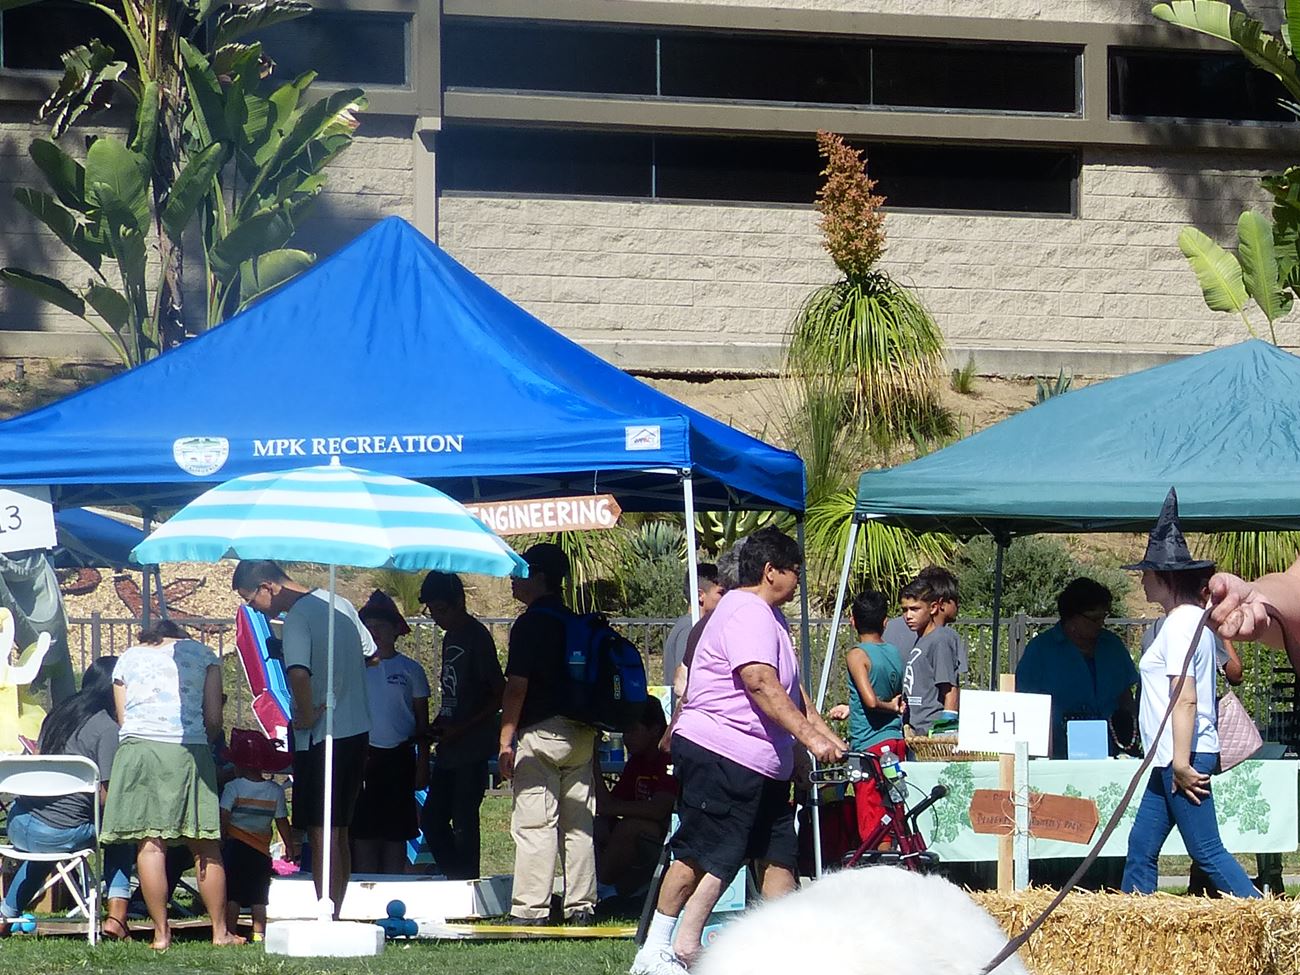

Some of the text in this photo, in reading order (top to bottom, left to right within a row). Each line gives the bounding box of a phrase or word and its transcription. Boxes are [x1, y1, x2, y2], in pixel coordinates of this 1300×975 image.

[252, 434, 464, 457] MPK RECREATION
[988, 711, 1016, 735] 14
